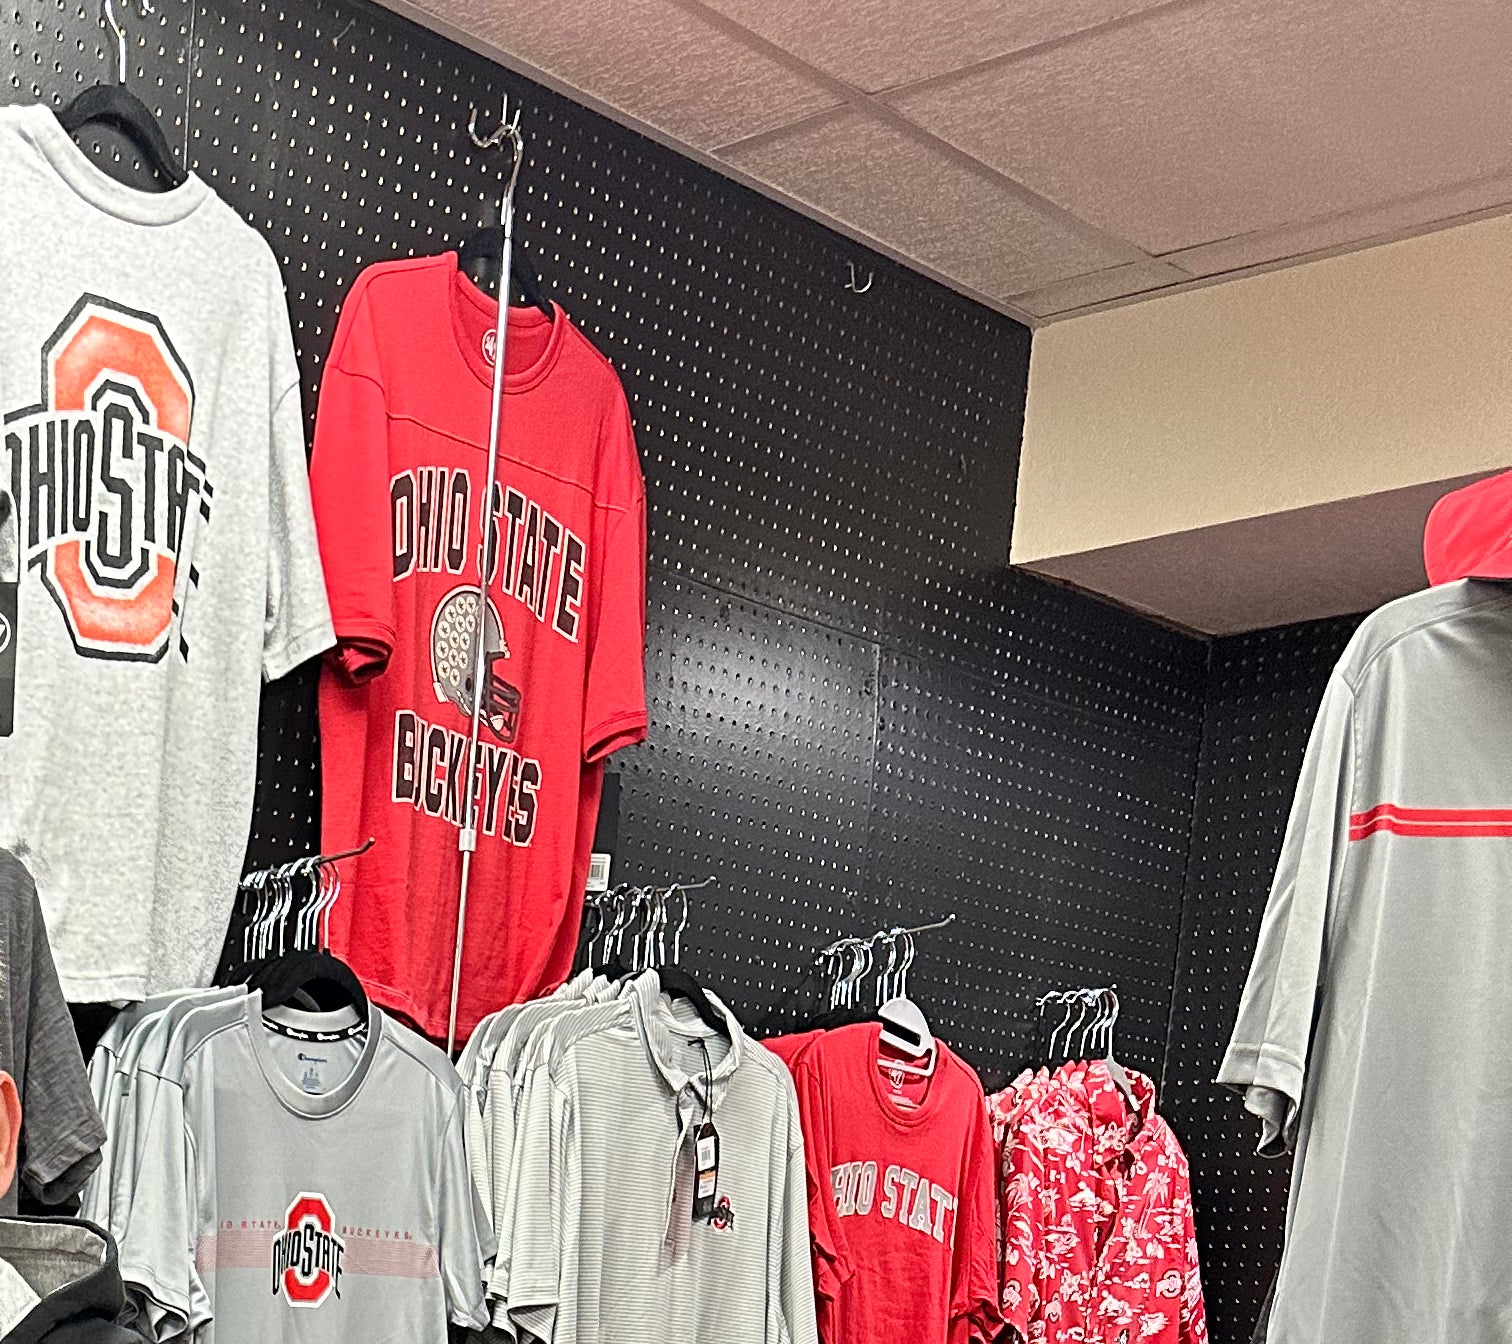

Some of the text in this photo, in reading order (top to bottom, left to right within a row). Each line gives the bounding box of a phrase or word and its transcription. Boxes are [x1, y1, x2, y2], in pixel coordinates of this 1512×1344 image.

[390, 466, 586, 643] OHIO STATE
[831, 1161, 959, 1250] HIO STAT
